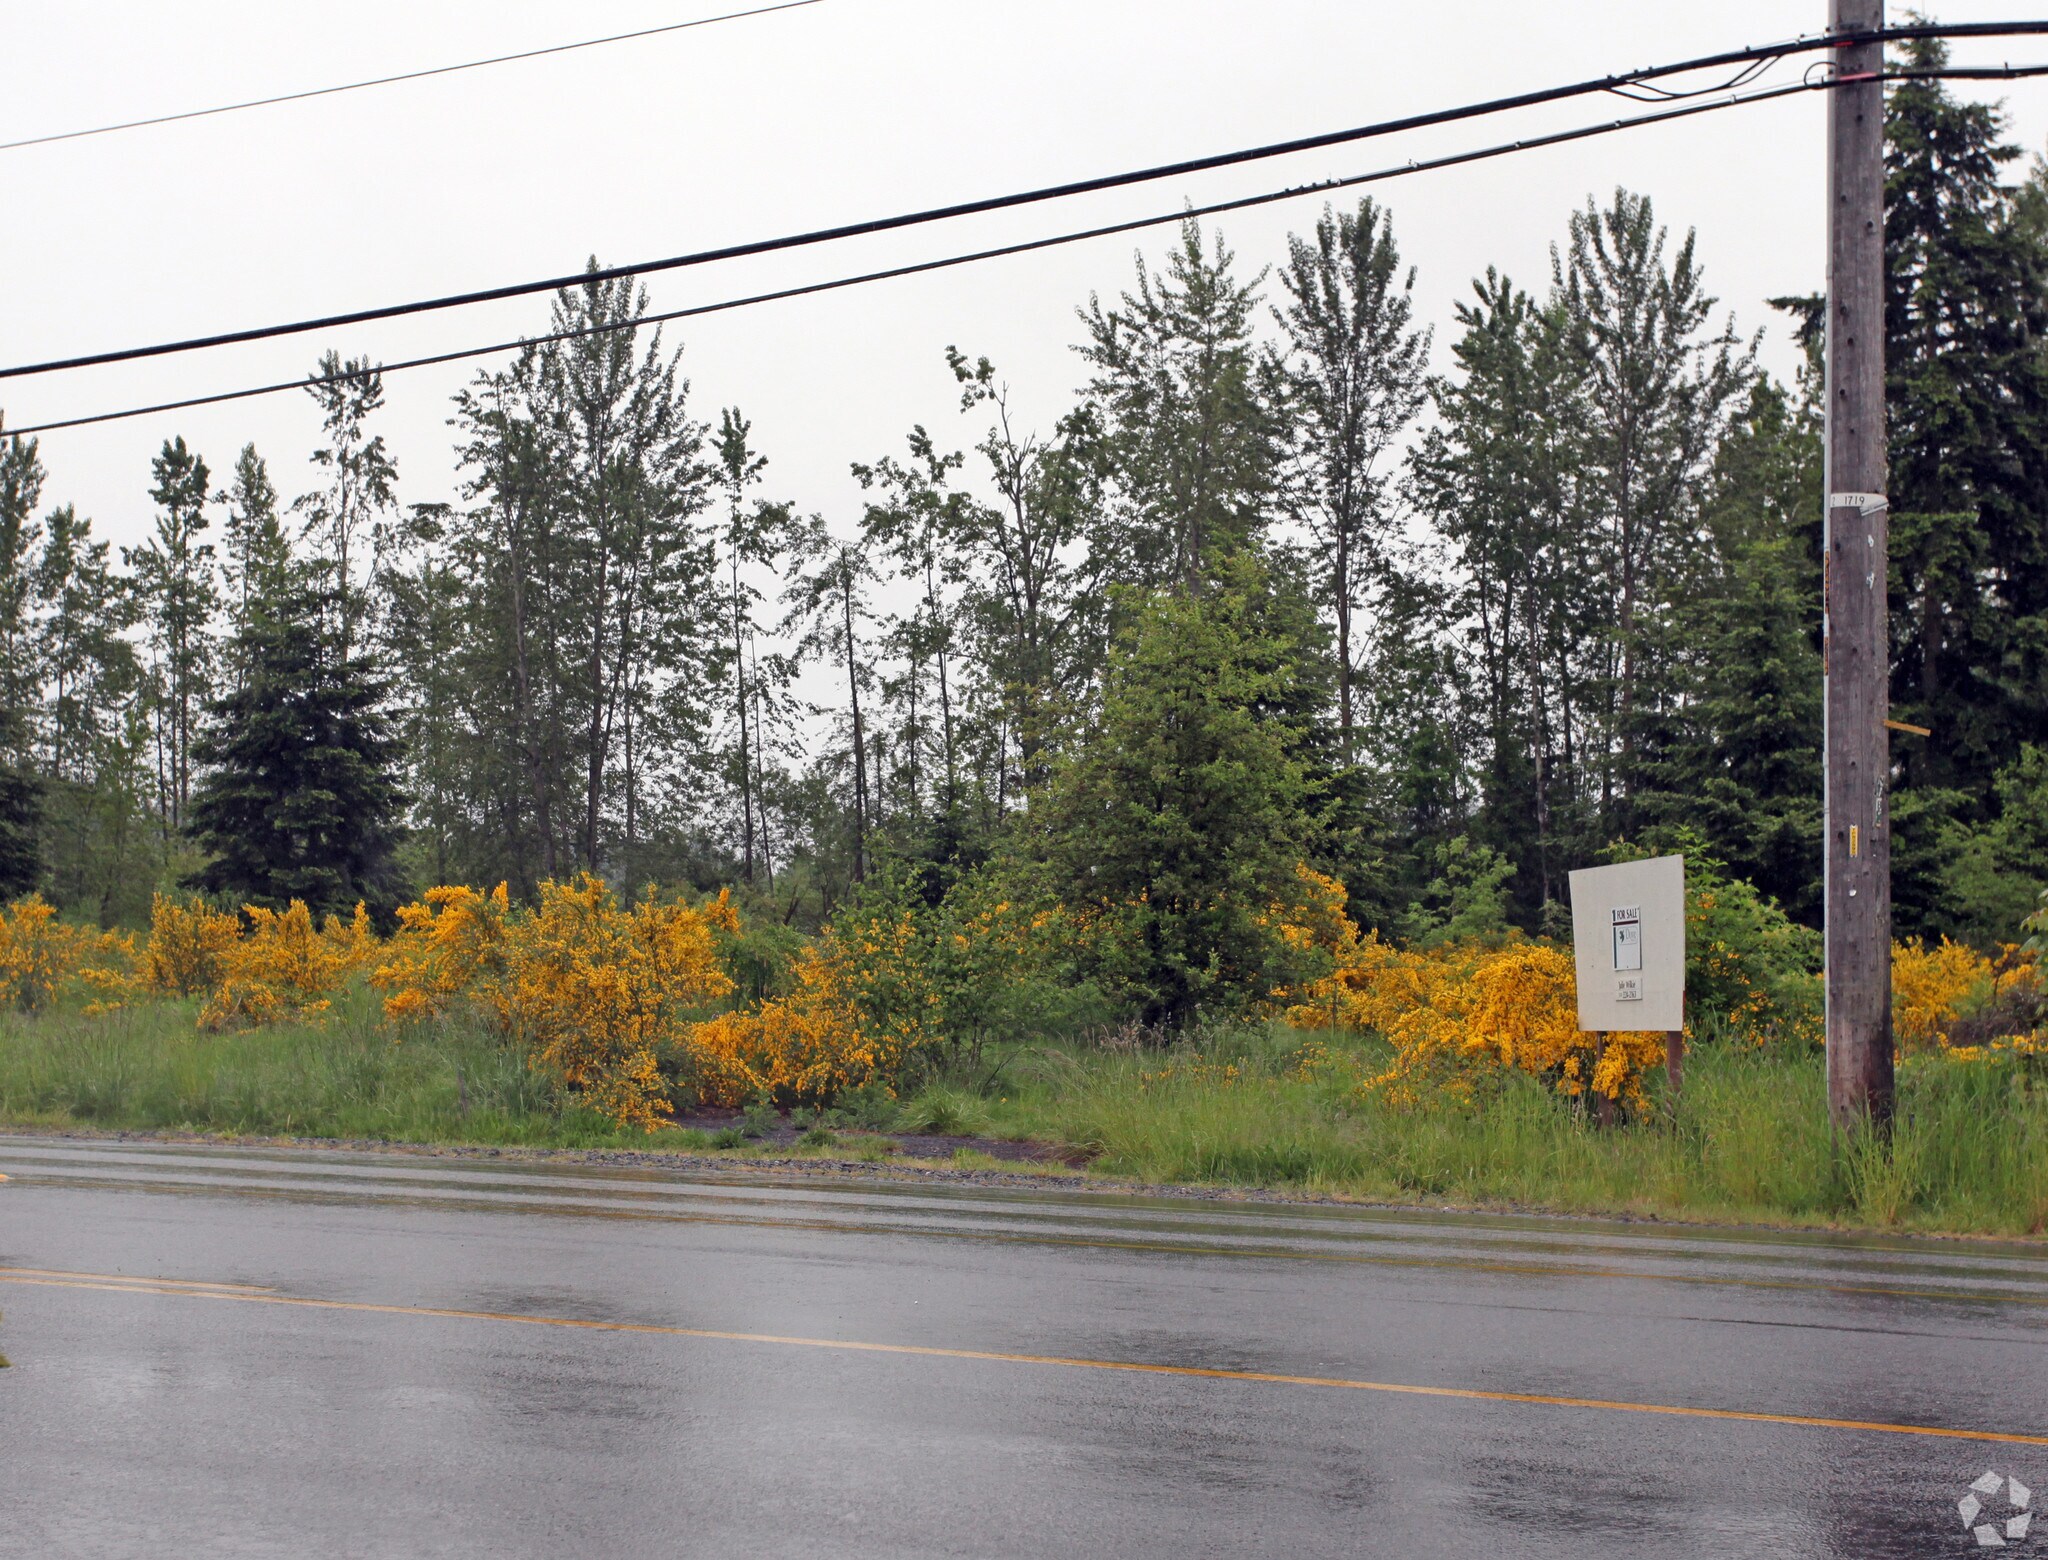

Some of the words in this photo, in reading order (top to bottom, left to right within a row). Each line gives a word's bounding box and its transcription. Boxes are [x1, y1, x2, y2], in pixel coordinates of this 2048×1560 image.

[1844, 496, 1865, 505] 1719
[1617, 909, 1626, 920] FOR
[1626, 908, 1637, 919] SALE
